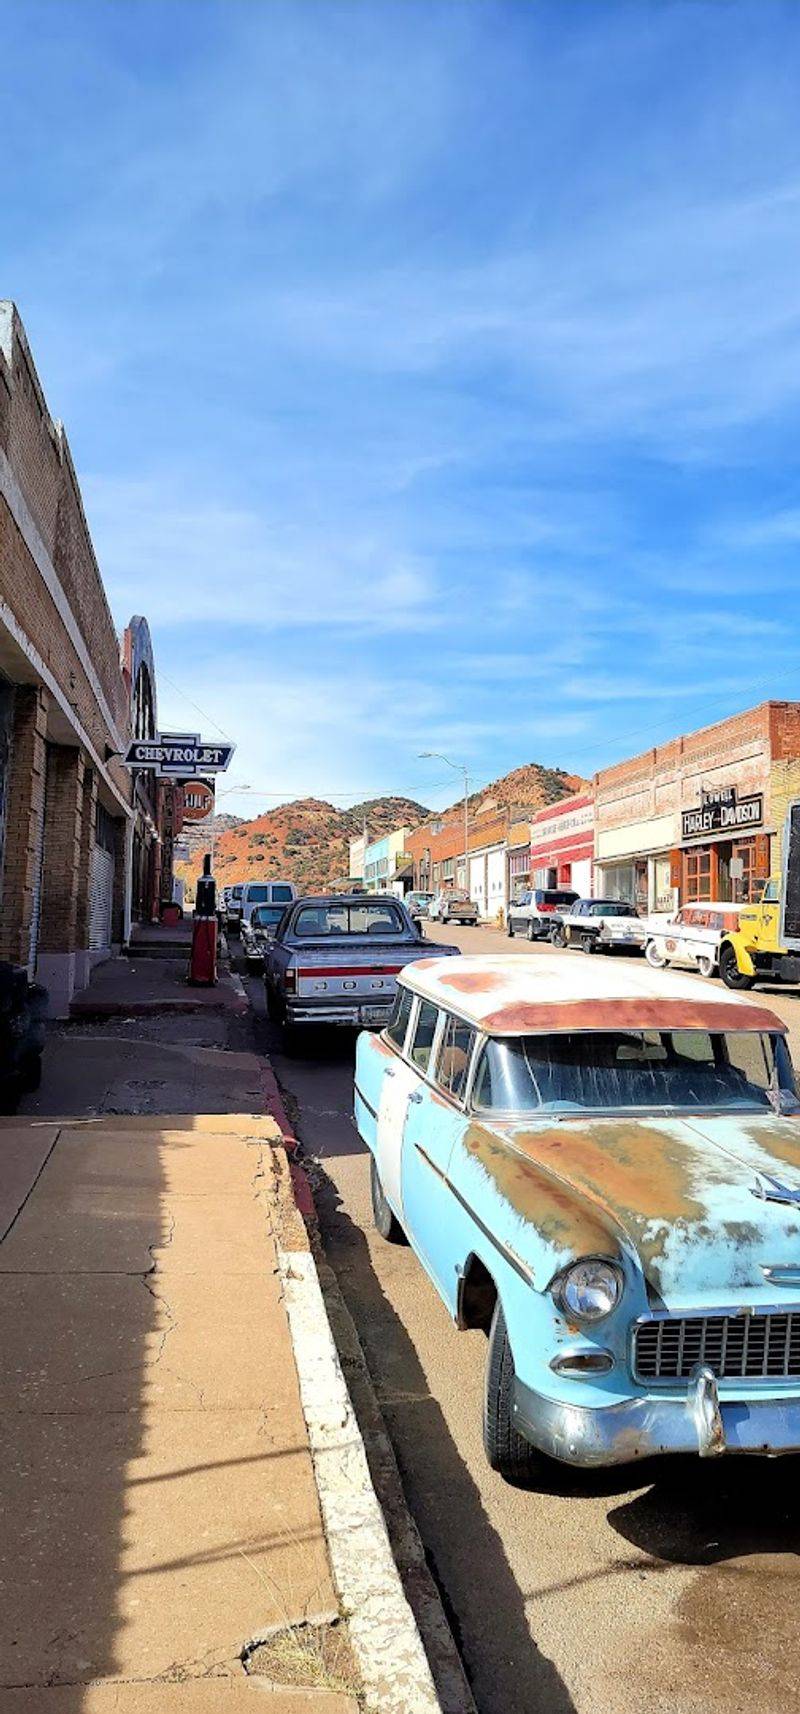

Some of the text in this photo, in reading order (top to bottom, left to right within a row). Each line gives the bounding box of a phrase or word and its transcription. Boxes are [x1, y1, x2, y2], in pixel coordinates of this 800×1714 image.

[135, 746, 223, 763] CHEVROLET
[184, 793, 212, 809] ULF
[314, 980, 385, 992] DOD
